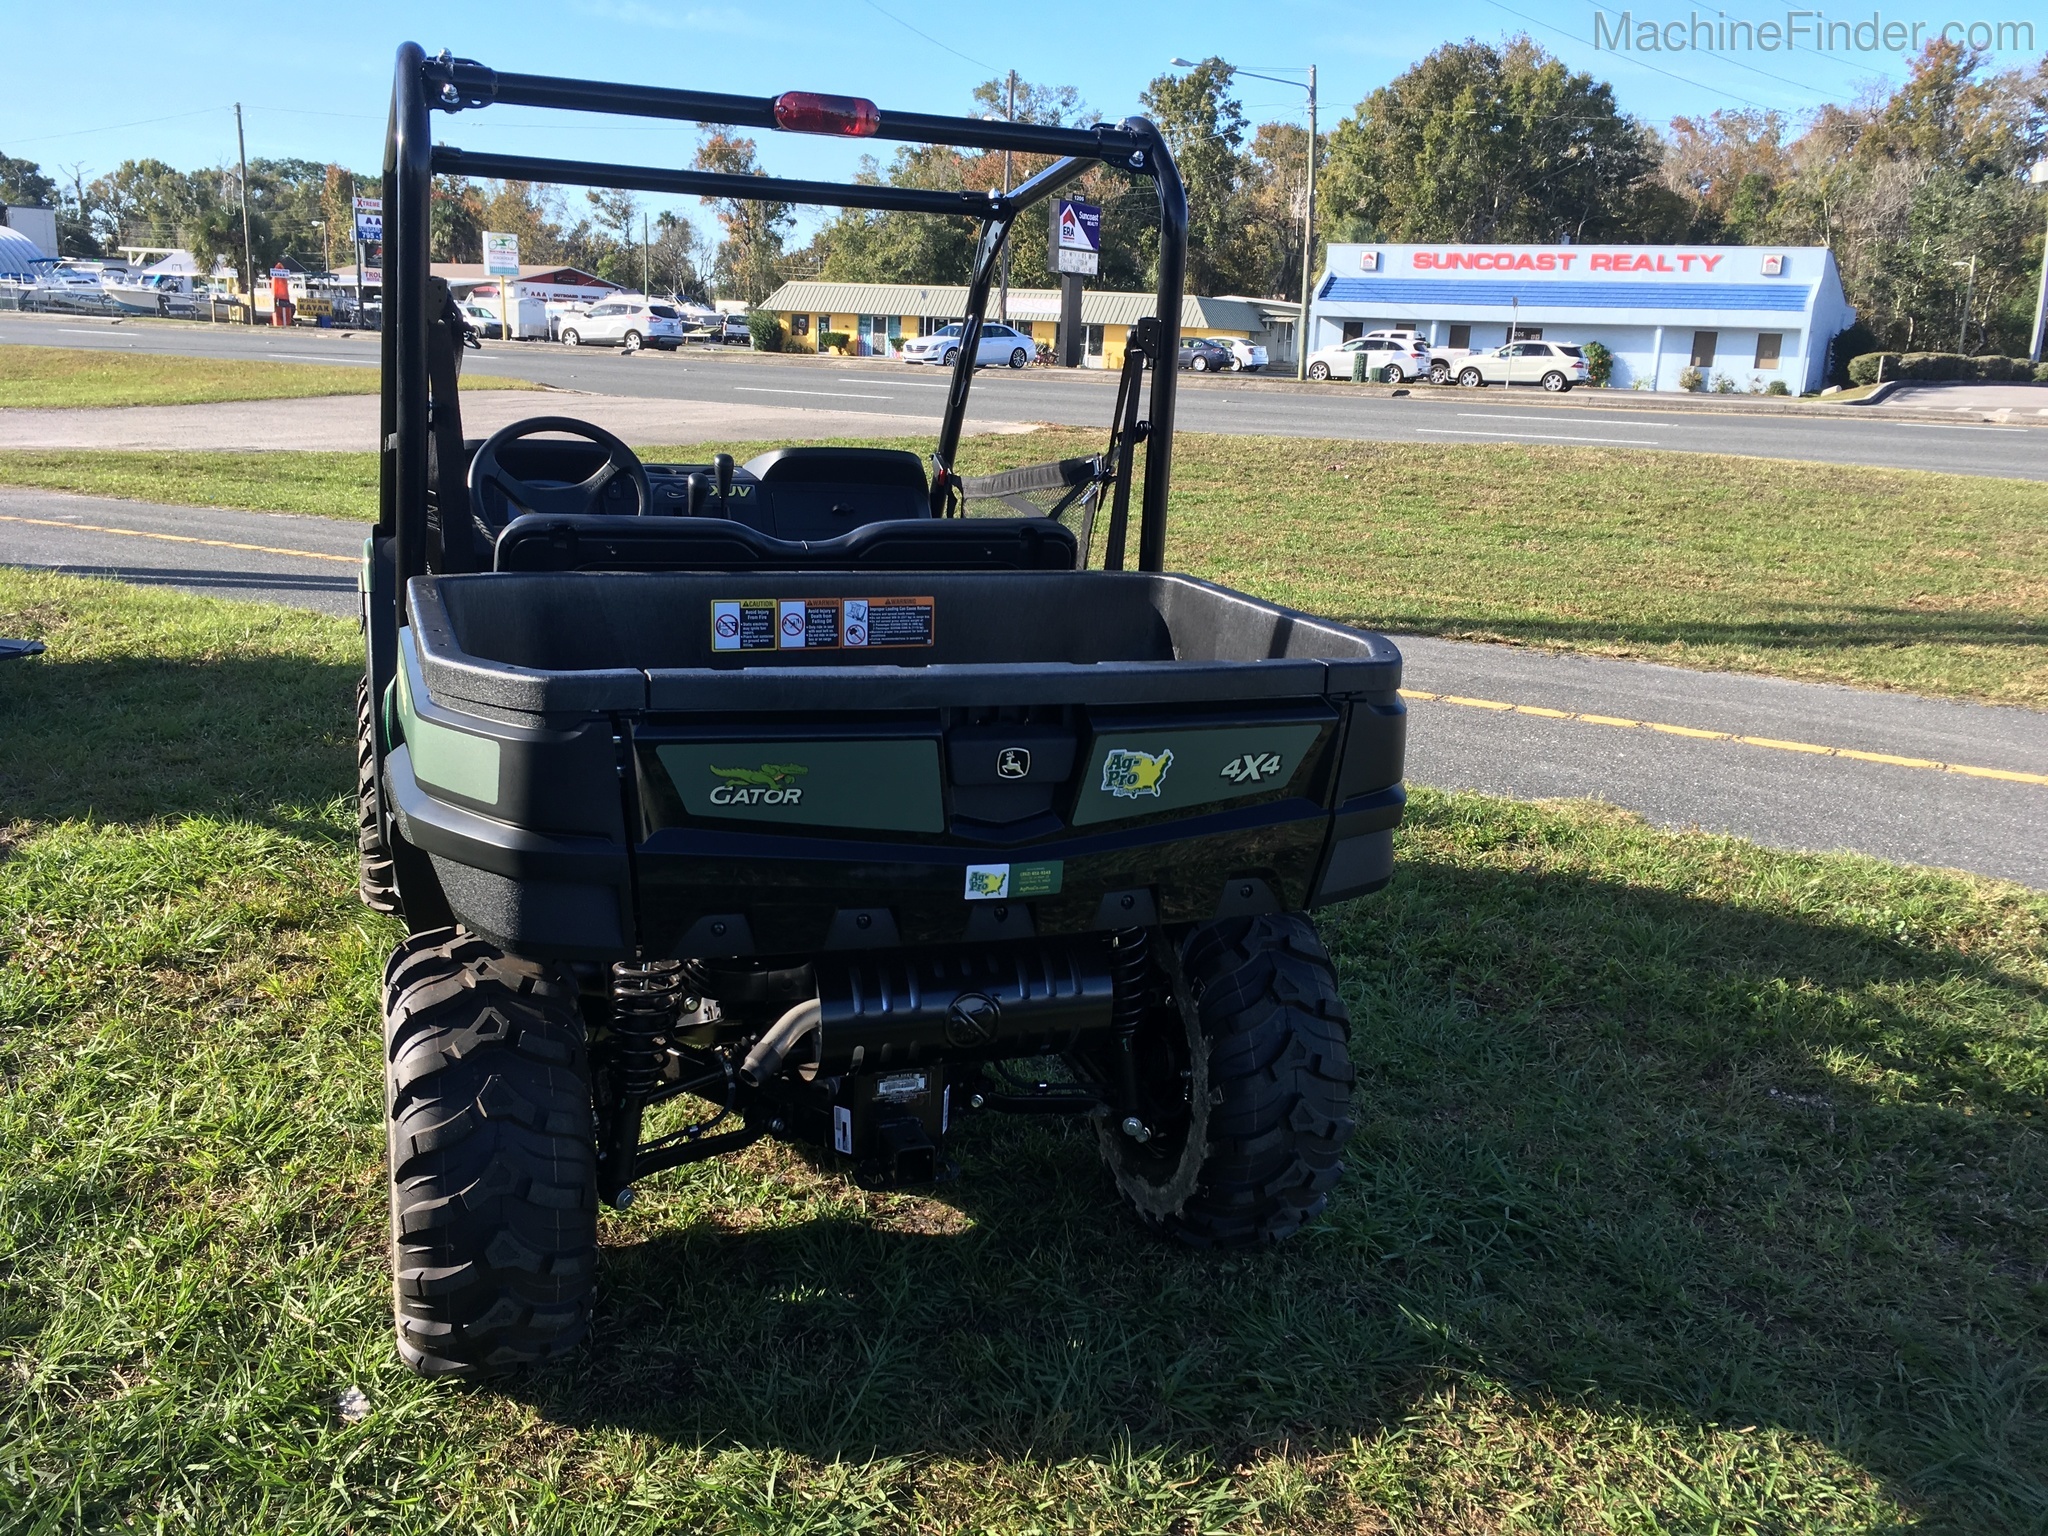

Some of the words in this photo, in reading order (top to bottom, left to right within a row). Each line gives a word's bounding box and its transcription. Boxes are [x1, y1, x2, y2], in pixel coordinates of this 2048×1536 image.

[357, 198, 380, 207] XTREME
[1079, 211, 1099, 222] Suncoast
[1063, 226, 1075, 237] ERA
[1412, 252, 1576, 271] SUNCOAST
[1590, 253, 1724, 272] REALTY
[300, 304, 329, 312] KAYAK
[1220, 753, 1281, 782] 4X4
[1106, 771, 1138, 787] Pro
[709, 785, 803, 805] GATOR
[969, 881, 988, 891] Pro
